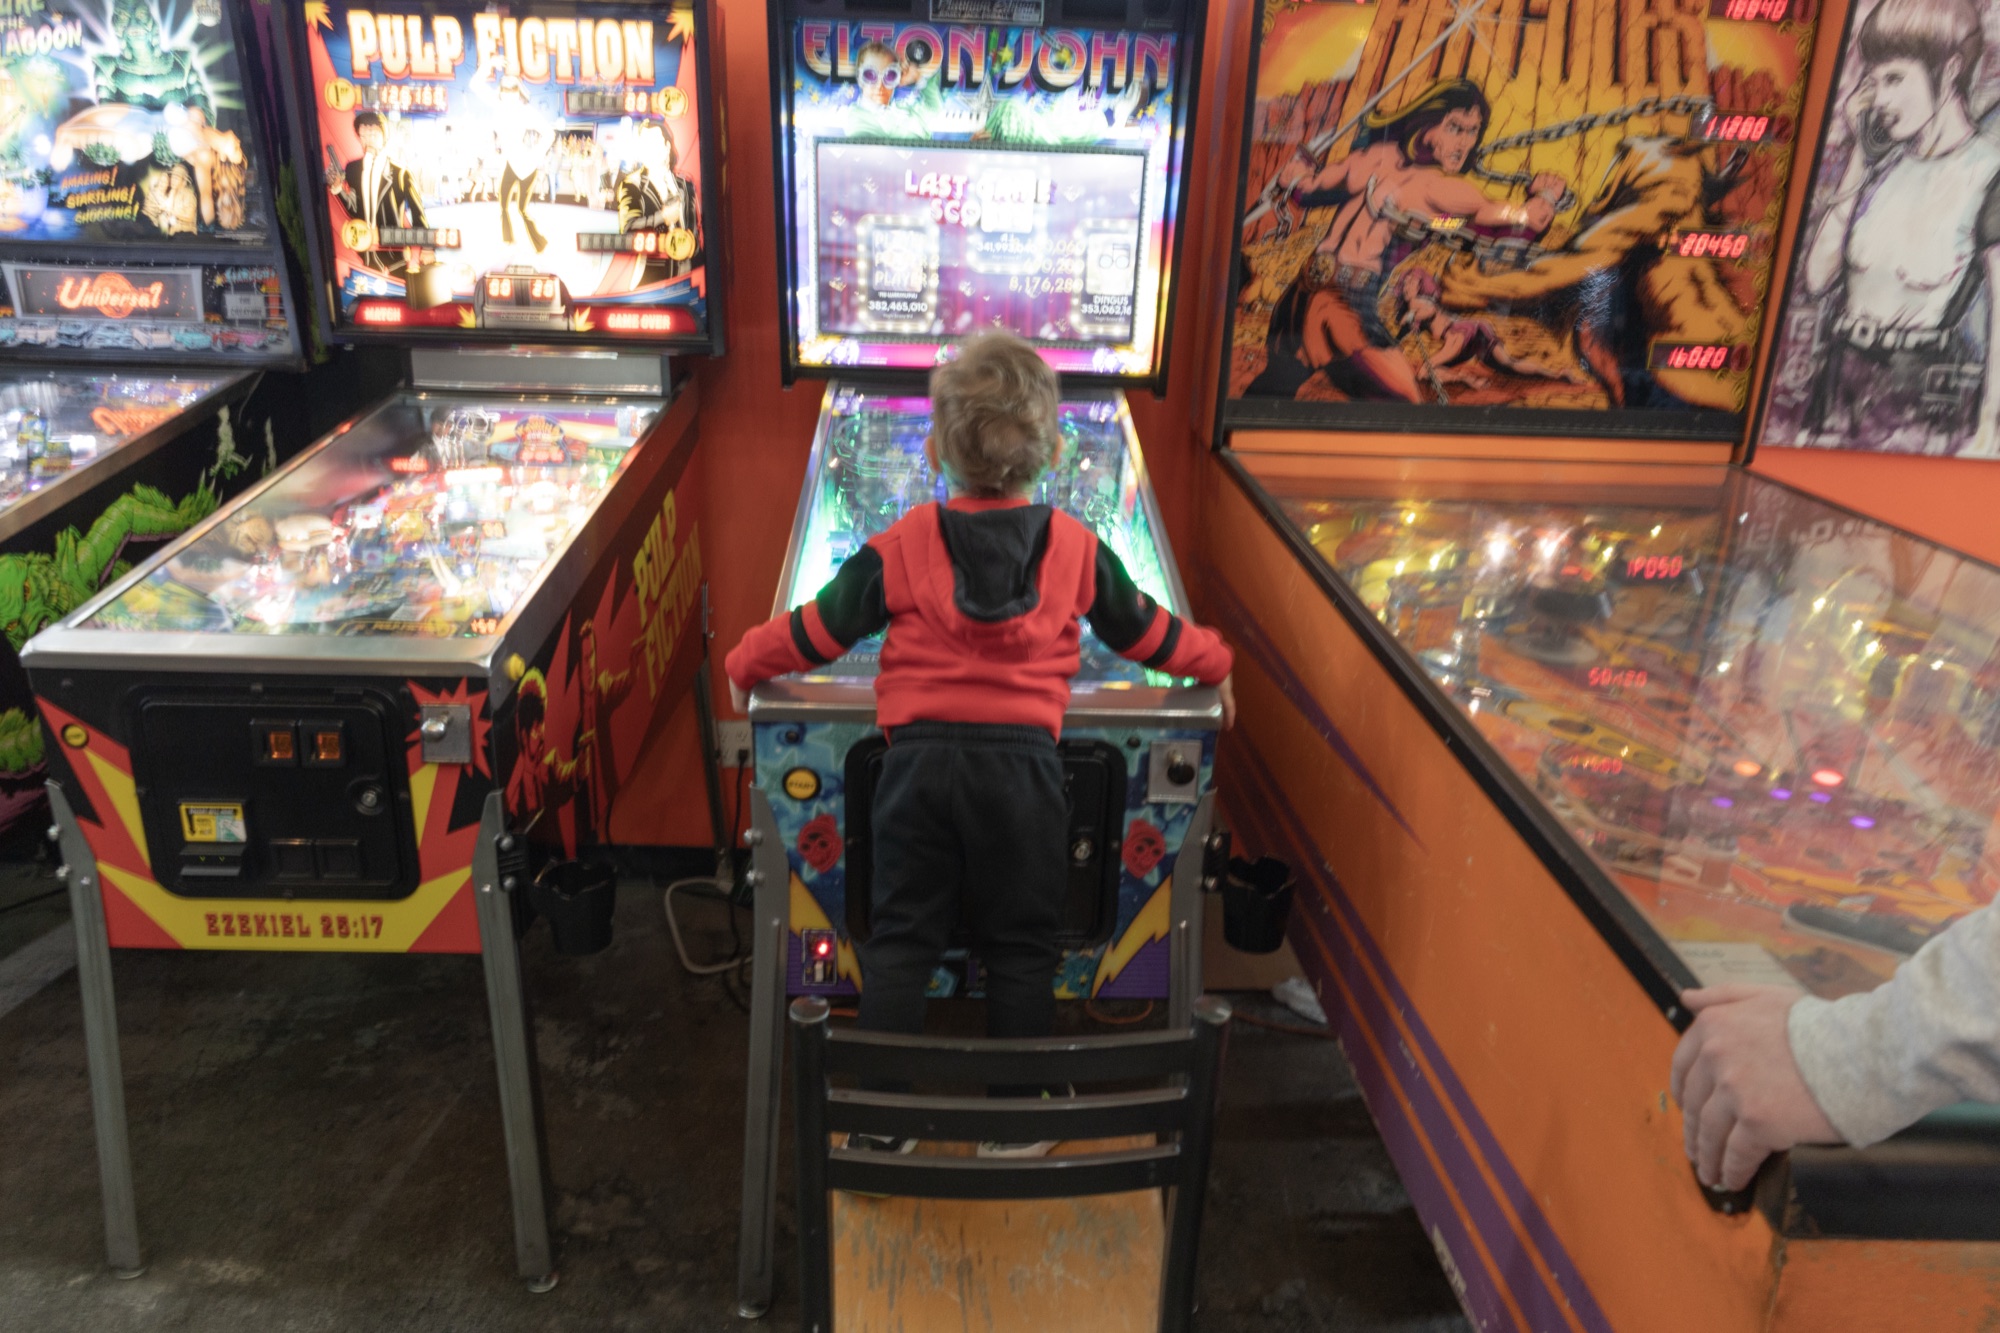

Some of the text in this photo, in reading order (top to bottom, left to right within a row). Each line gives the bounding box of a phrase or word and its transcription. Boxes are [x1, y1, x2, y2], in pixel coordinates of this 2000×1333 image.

[346, 9, 656, 86] PULP FICTION
[1003, 27, 1172, 90] JOHN
[904, 169, 968, 201] LAST
[607, 313, 671, 330] GAME OVER
[633, 487, 677, 630] PULP
[205, 912, 384, 939] EZEKIEL 25:17
